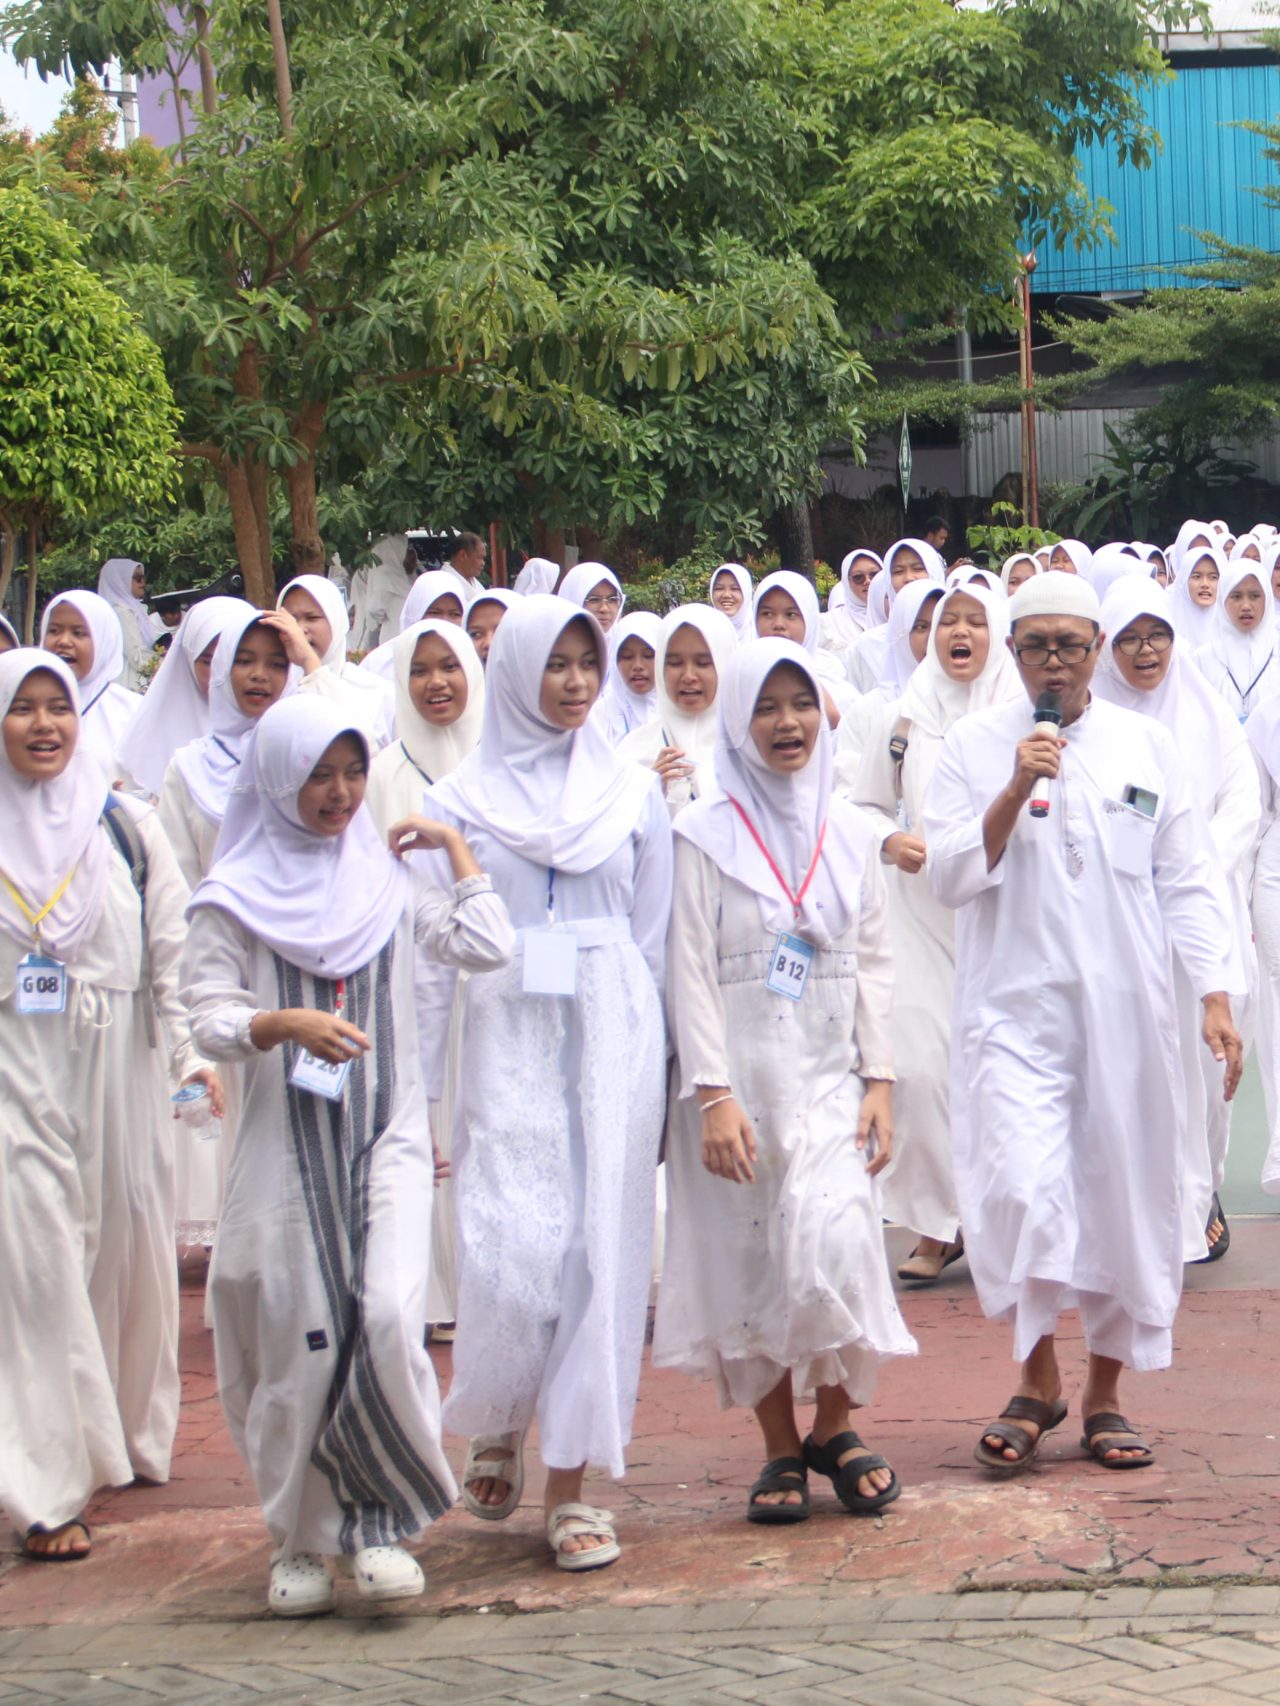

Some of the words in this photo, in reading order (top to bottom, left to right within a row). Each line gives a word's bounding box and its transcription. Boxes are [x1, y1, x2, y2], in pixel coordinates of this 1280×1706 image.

[776, 954, 787, 972] B
[789, 961, 805, 981] 12
[23, 976, 33, 993] G
[36, 976, 59, 993] 08
